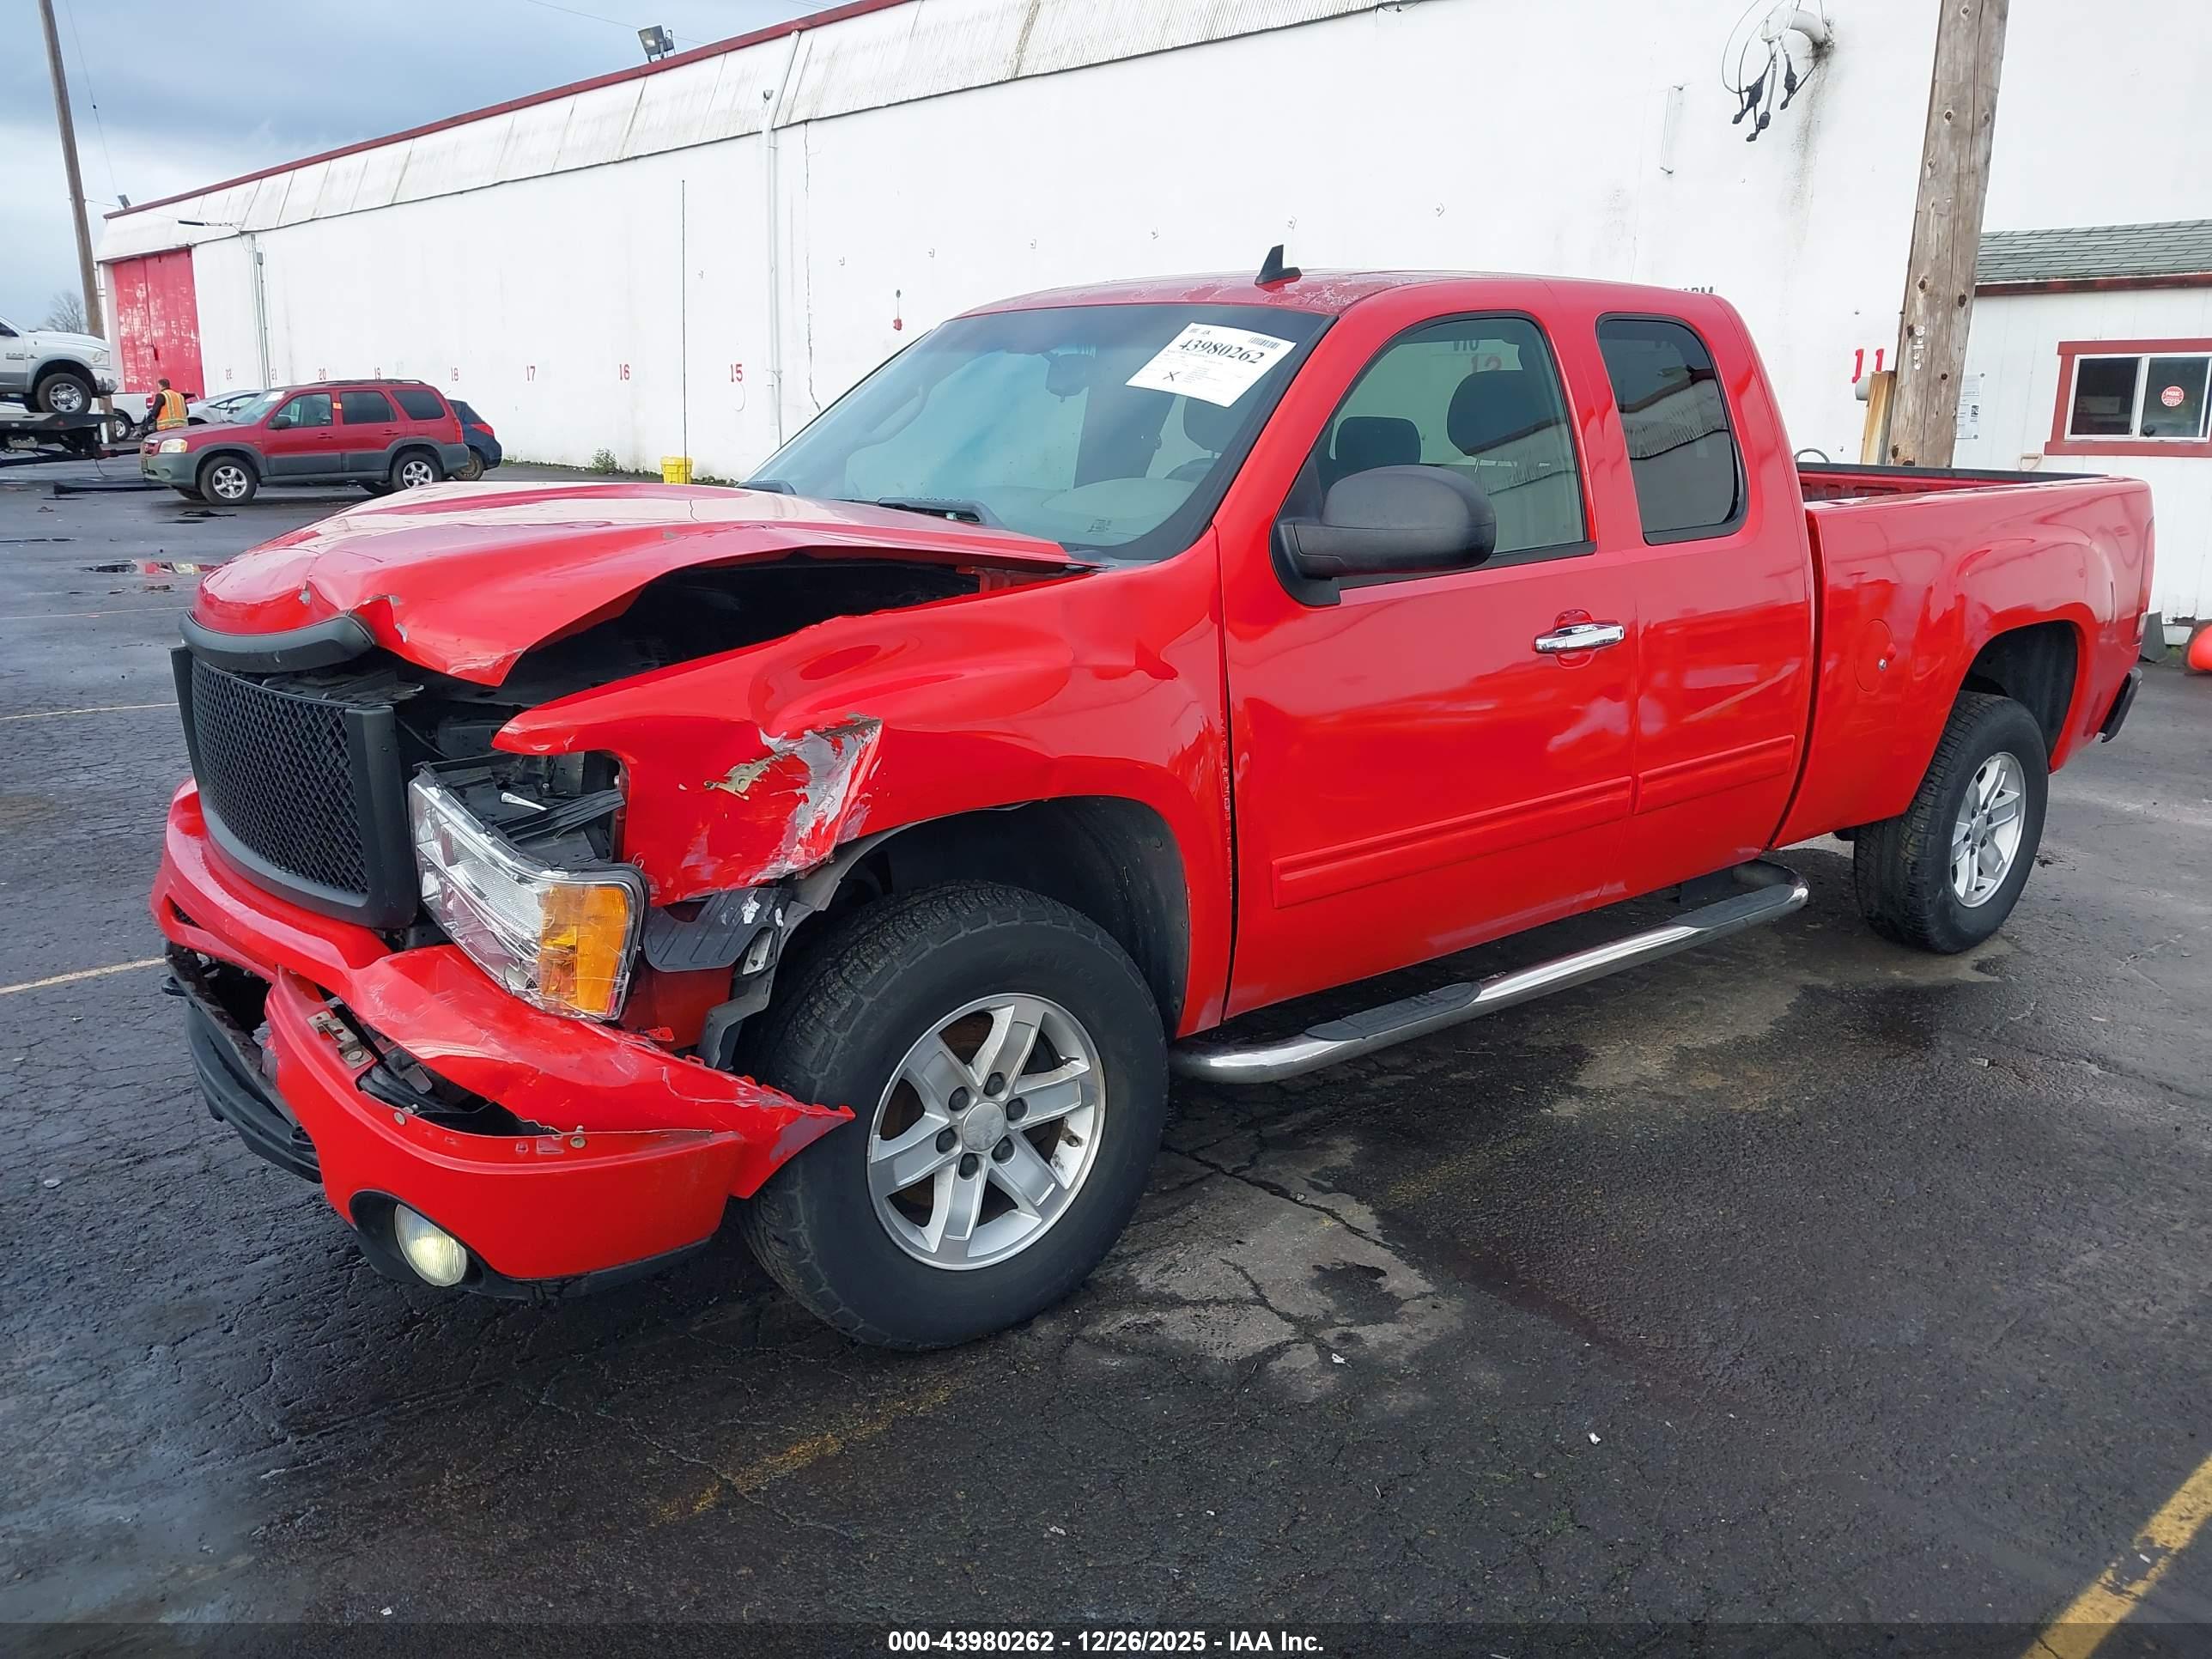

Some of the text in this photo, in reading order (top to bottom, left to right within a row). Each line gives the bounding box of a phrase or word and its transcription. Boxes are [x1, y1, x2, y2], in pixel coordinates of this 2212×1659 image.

[1179, 338, 1265, 364] 43980262
[319, 368, 326, 380] 20
[450, 367, 459, 381] 18
[526, 365, 536, 381] 17
[619, 363, 630, 380] 16
[730, 363, 743, 382] 15
[1851, 349, 1884, 384] 11
